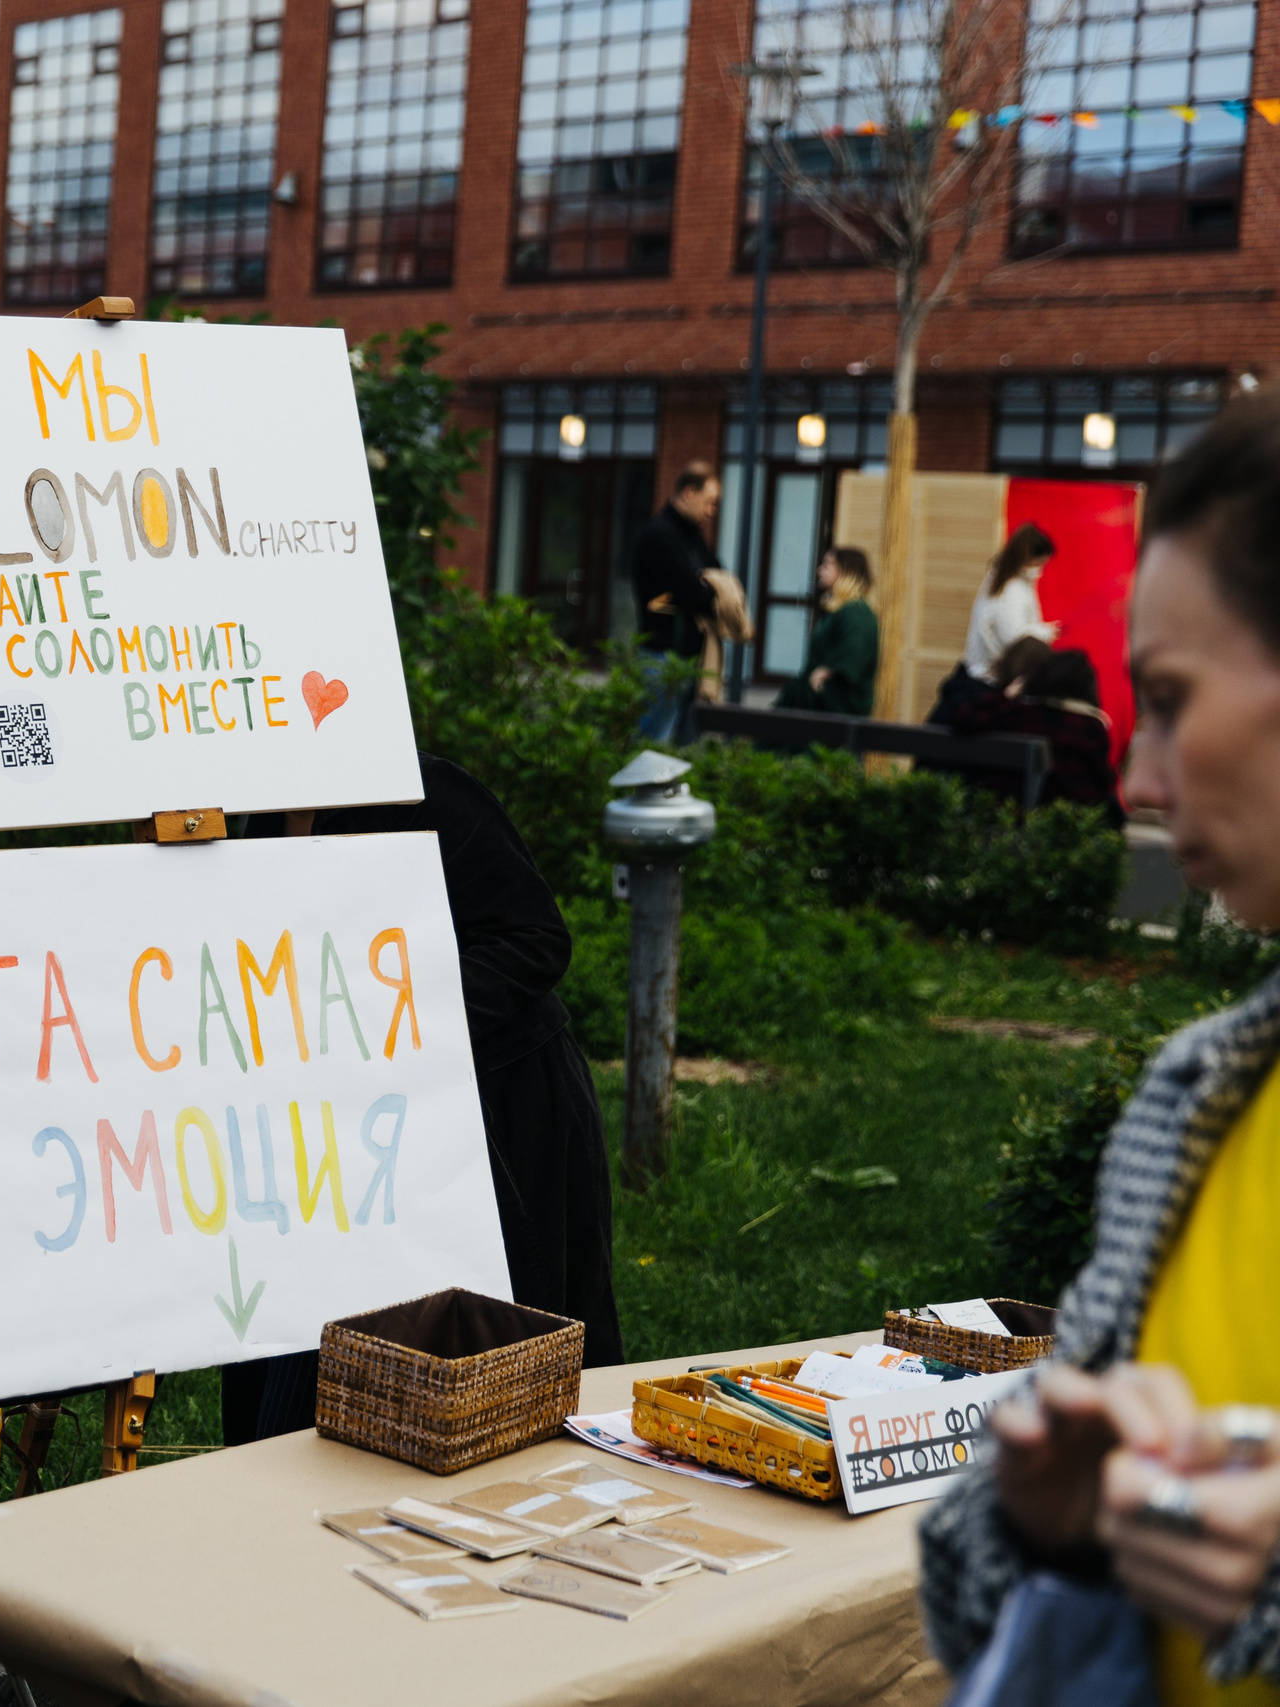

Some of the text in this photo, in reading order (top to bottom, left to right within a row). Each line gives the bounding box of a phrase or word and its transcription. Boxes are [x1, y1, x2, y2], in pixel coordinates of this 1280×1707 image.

[26, 348, 160, 446] МЫ
[5, 621, 261, 678] СОЛОМОНИТЬ
[123, 675, 289, 741] ВМЕСТЕ
[128, 927, 422, 1073] САМАЯ
[32, 1094, 407, 1252] ЭМОЦИЯ
[848, 1414, 872, 1454] Я
[877, 1410, 936, 1450] ДРУГ
